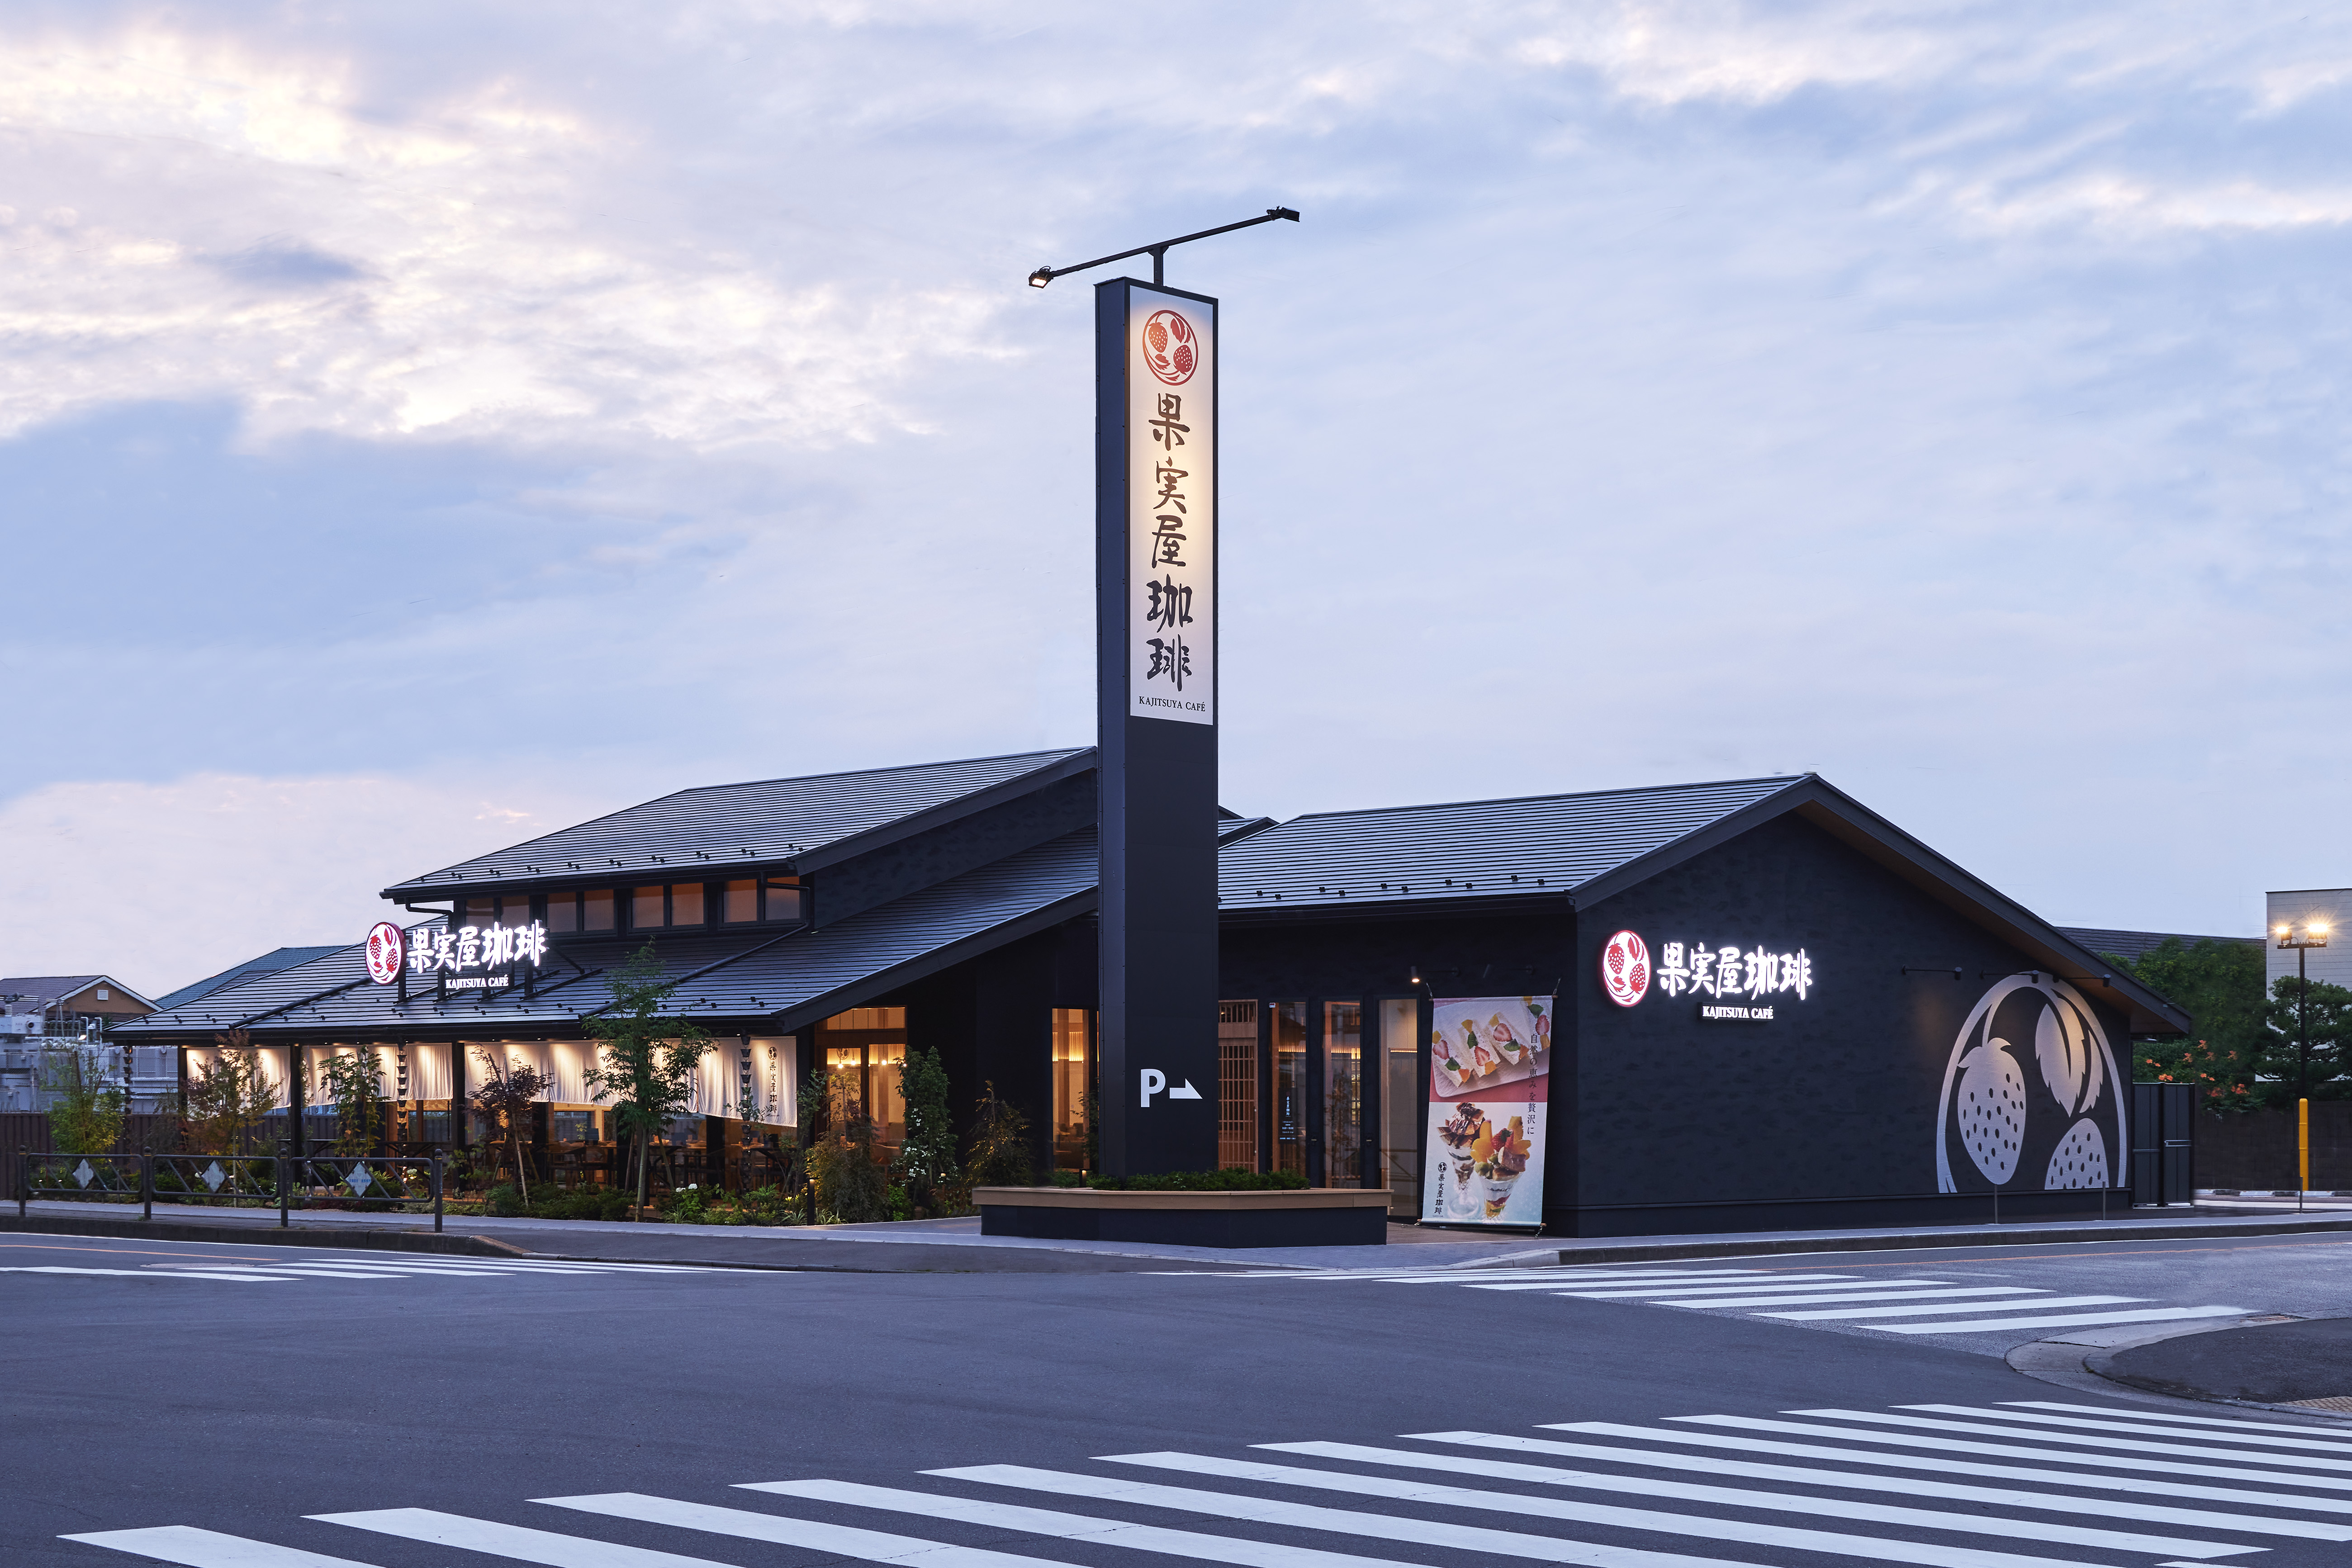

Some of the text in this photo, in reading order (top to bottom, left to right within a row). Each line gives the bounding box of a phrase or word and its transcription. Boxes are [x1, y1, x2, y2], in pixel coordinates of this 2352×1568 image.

[1146, 392, 1193, 692] 果実屋珈琲
[1139, 696, 1205, 712] KAJITSUYA CAFÉ
[407, 919, 547, 974] 果実屋珈琲
[446, 974, 509, 990] KAJITSUYA CAFÉ
[1657, 942, 1813, 1000] 果実屋珈琲
[1702, 1005, 1774, 1019] KAJITSUYA CAFÉ
[1141, 1068, 1166, 1107] P
[1527, 1033, 1538, 1135] 自然の恵みを贅沢に
[1434, 1173, 1445, 1215] 果実屋珈琲
